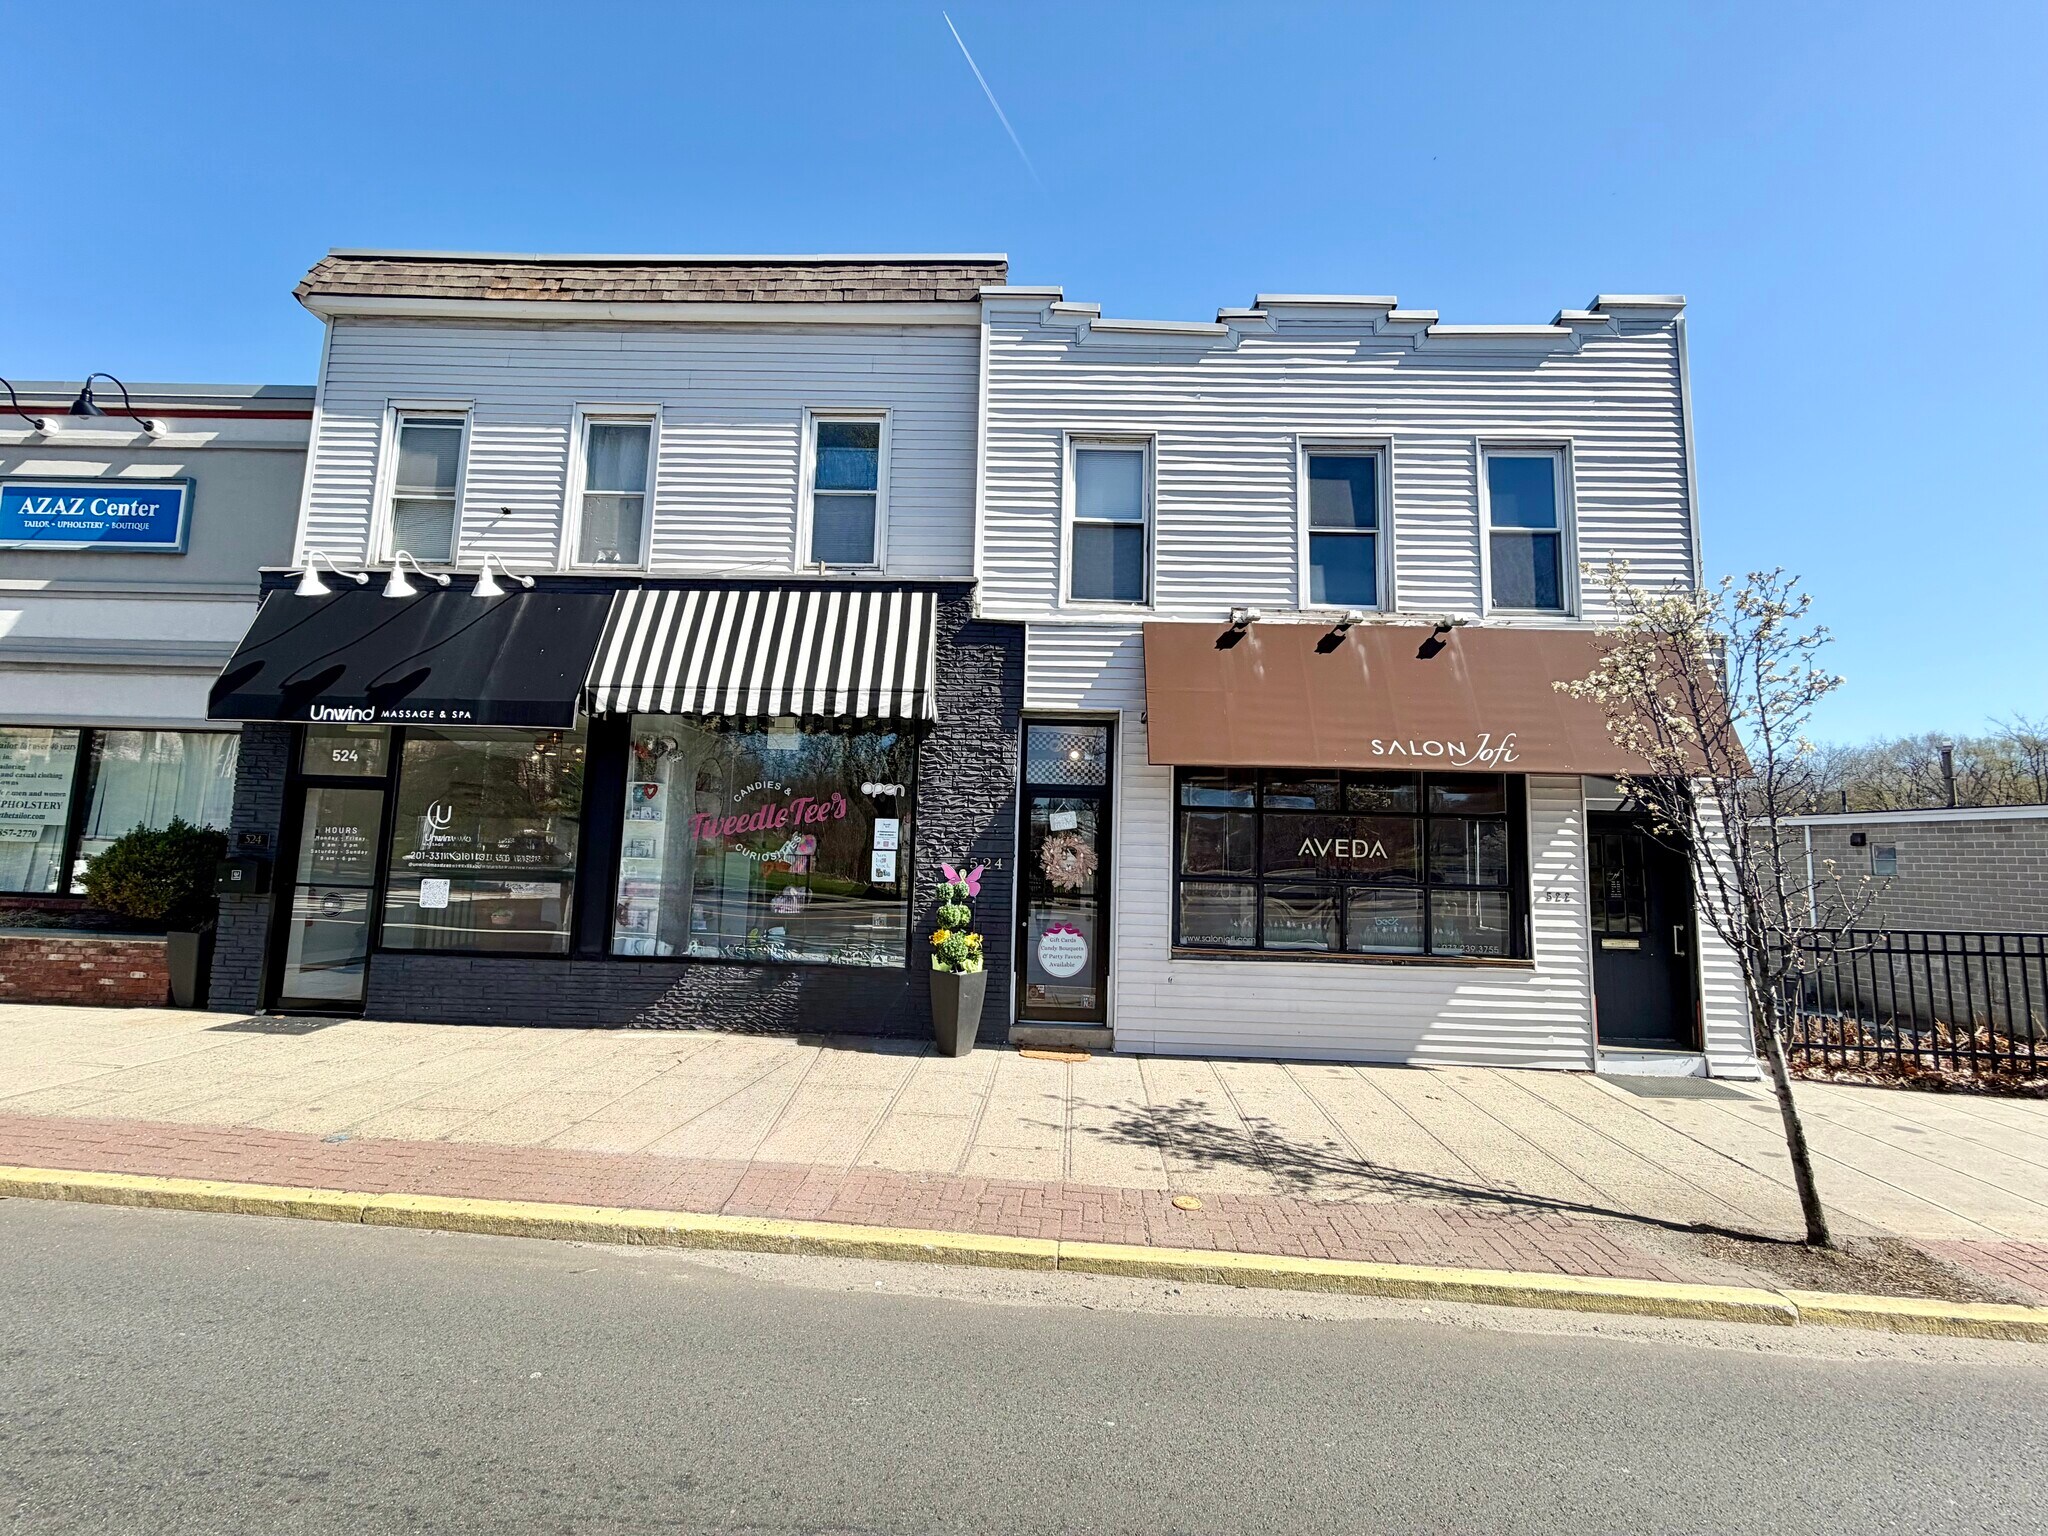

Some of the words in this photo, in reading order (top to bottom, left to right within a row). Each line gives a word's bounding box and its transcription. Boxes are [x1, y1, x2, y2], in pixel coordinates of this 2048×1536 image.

[18, 497, 85, 516] AZAZ
[90, 498, 159, 517] Center
[24, 520, 50, 529] TAILOR
[57, 521, 104, 530] UPHOLSTERY
[111, 522, 150, 531] BOUTIQUE
[310, 704, 376, 721] Unwind
[381, 710, 434, 719] MASSAGE
[439, 710, 447, 719] &
[452, 710, 472, 719] SPA
[60, 744, 76, 752] years
[1371, 739, 1467, 757] SALON
[1451, 733, 1520, 768] Jofi
[332, 750, 358, 763] 524
[38, 772, 63, 780] clothing
[733, 780, 782, 802] CANDIES
[784, 787, 792, 797] &
[861, 782, 905, 798] open
[0, 800, 63, 810] PHOLSTERY
[325, 826, 358, 834] HOURS
[245, 834, 262, 845] 524
[735, 835, 802, 862] CURIOSITIES
[1297, 837, 1388, 859] AVEDA
[970, 857, 1003, 870] 524
[1545, 891, 1570, 902] 522
